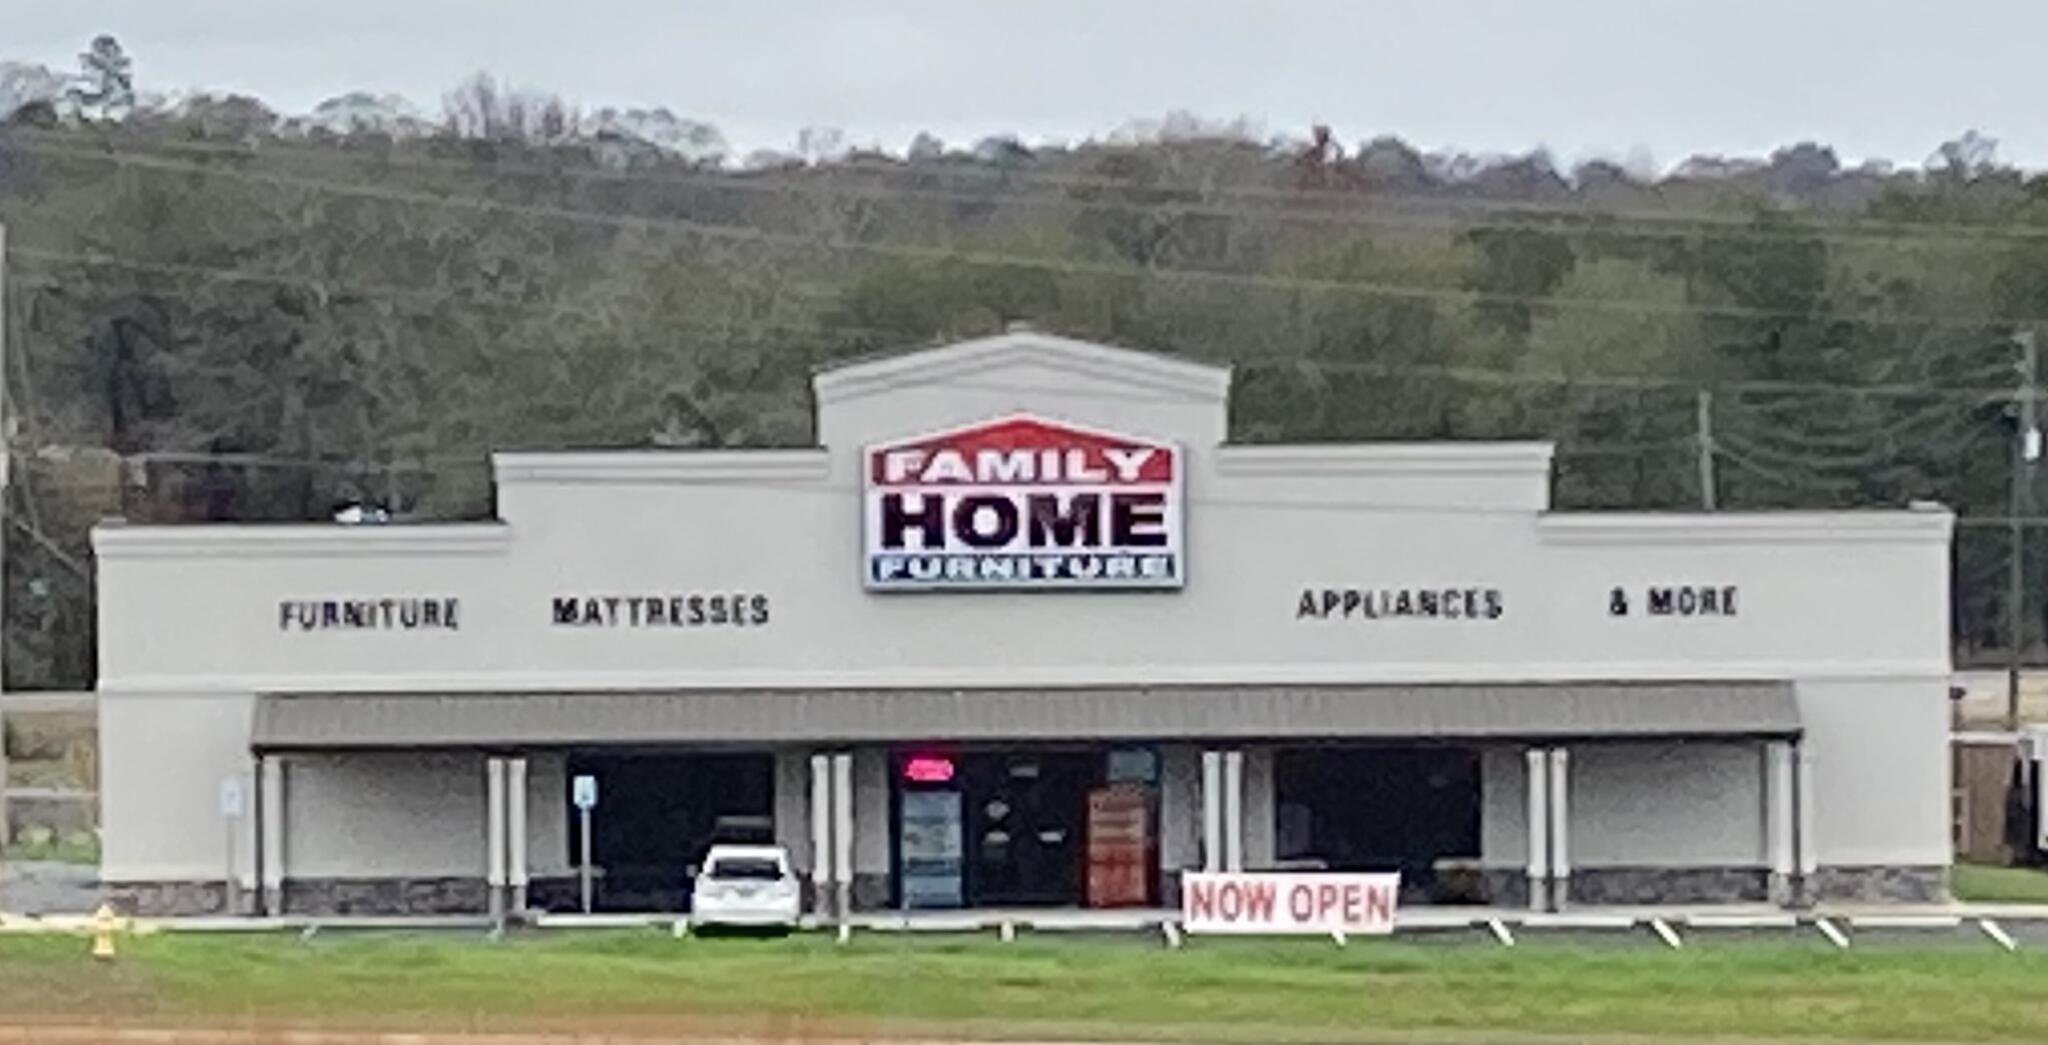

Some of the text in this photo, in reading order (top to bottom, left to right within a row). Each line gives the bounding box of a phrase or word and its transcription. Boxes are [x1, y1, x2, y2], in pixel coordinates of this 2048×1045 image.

[884, 449, 1155, 482] FAMILY
[882, 493, 1167, 549] HOME
[878, 555, 1169, 580] FURNITURE
[280, 596, 770, 630] FURNITURE MATTRESSES
[1297, 586, 1738, 619] APPLIANCES & MORE
[1190, 881, 1390, 923] NOW OPEN
